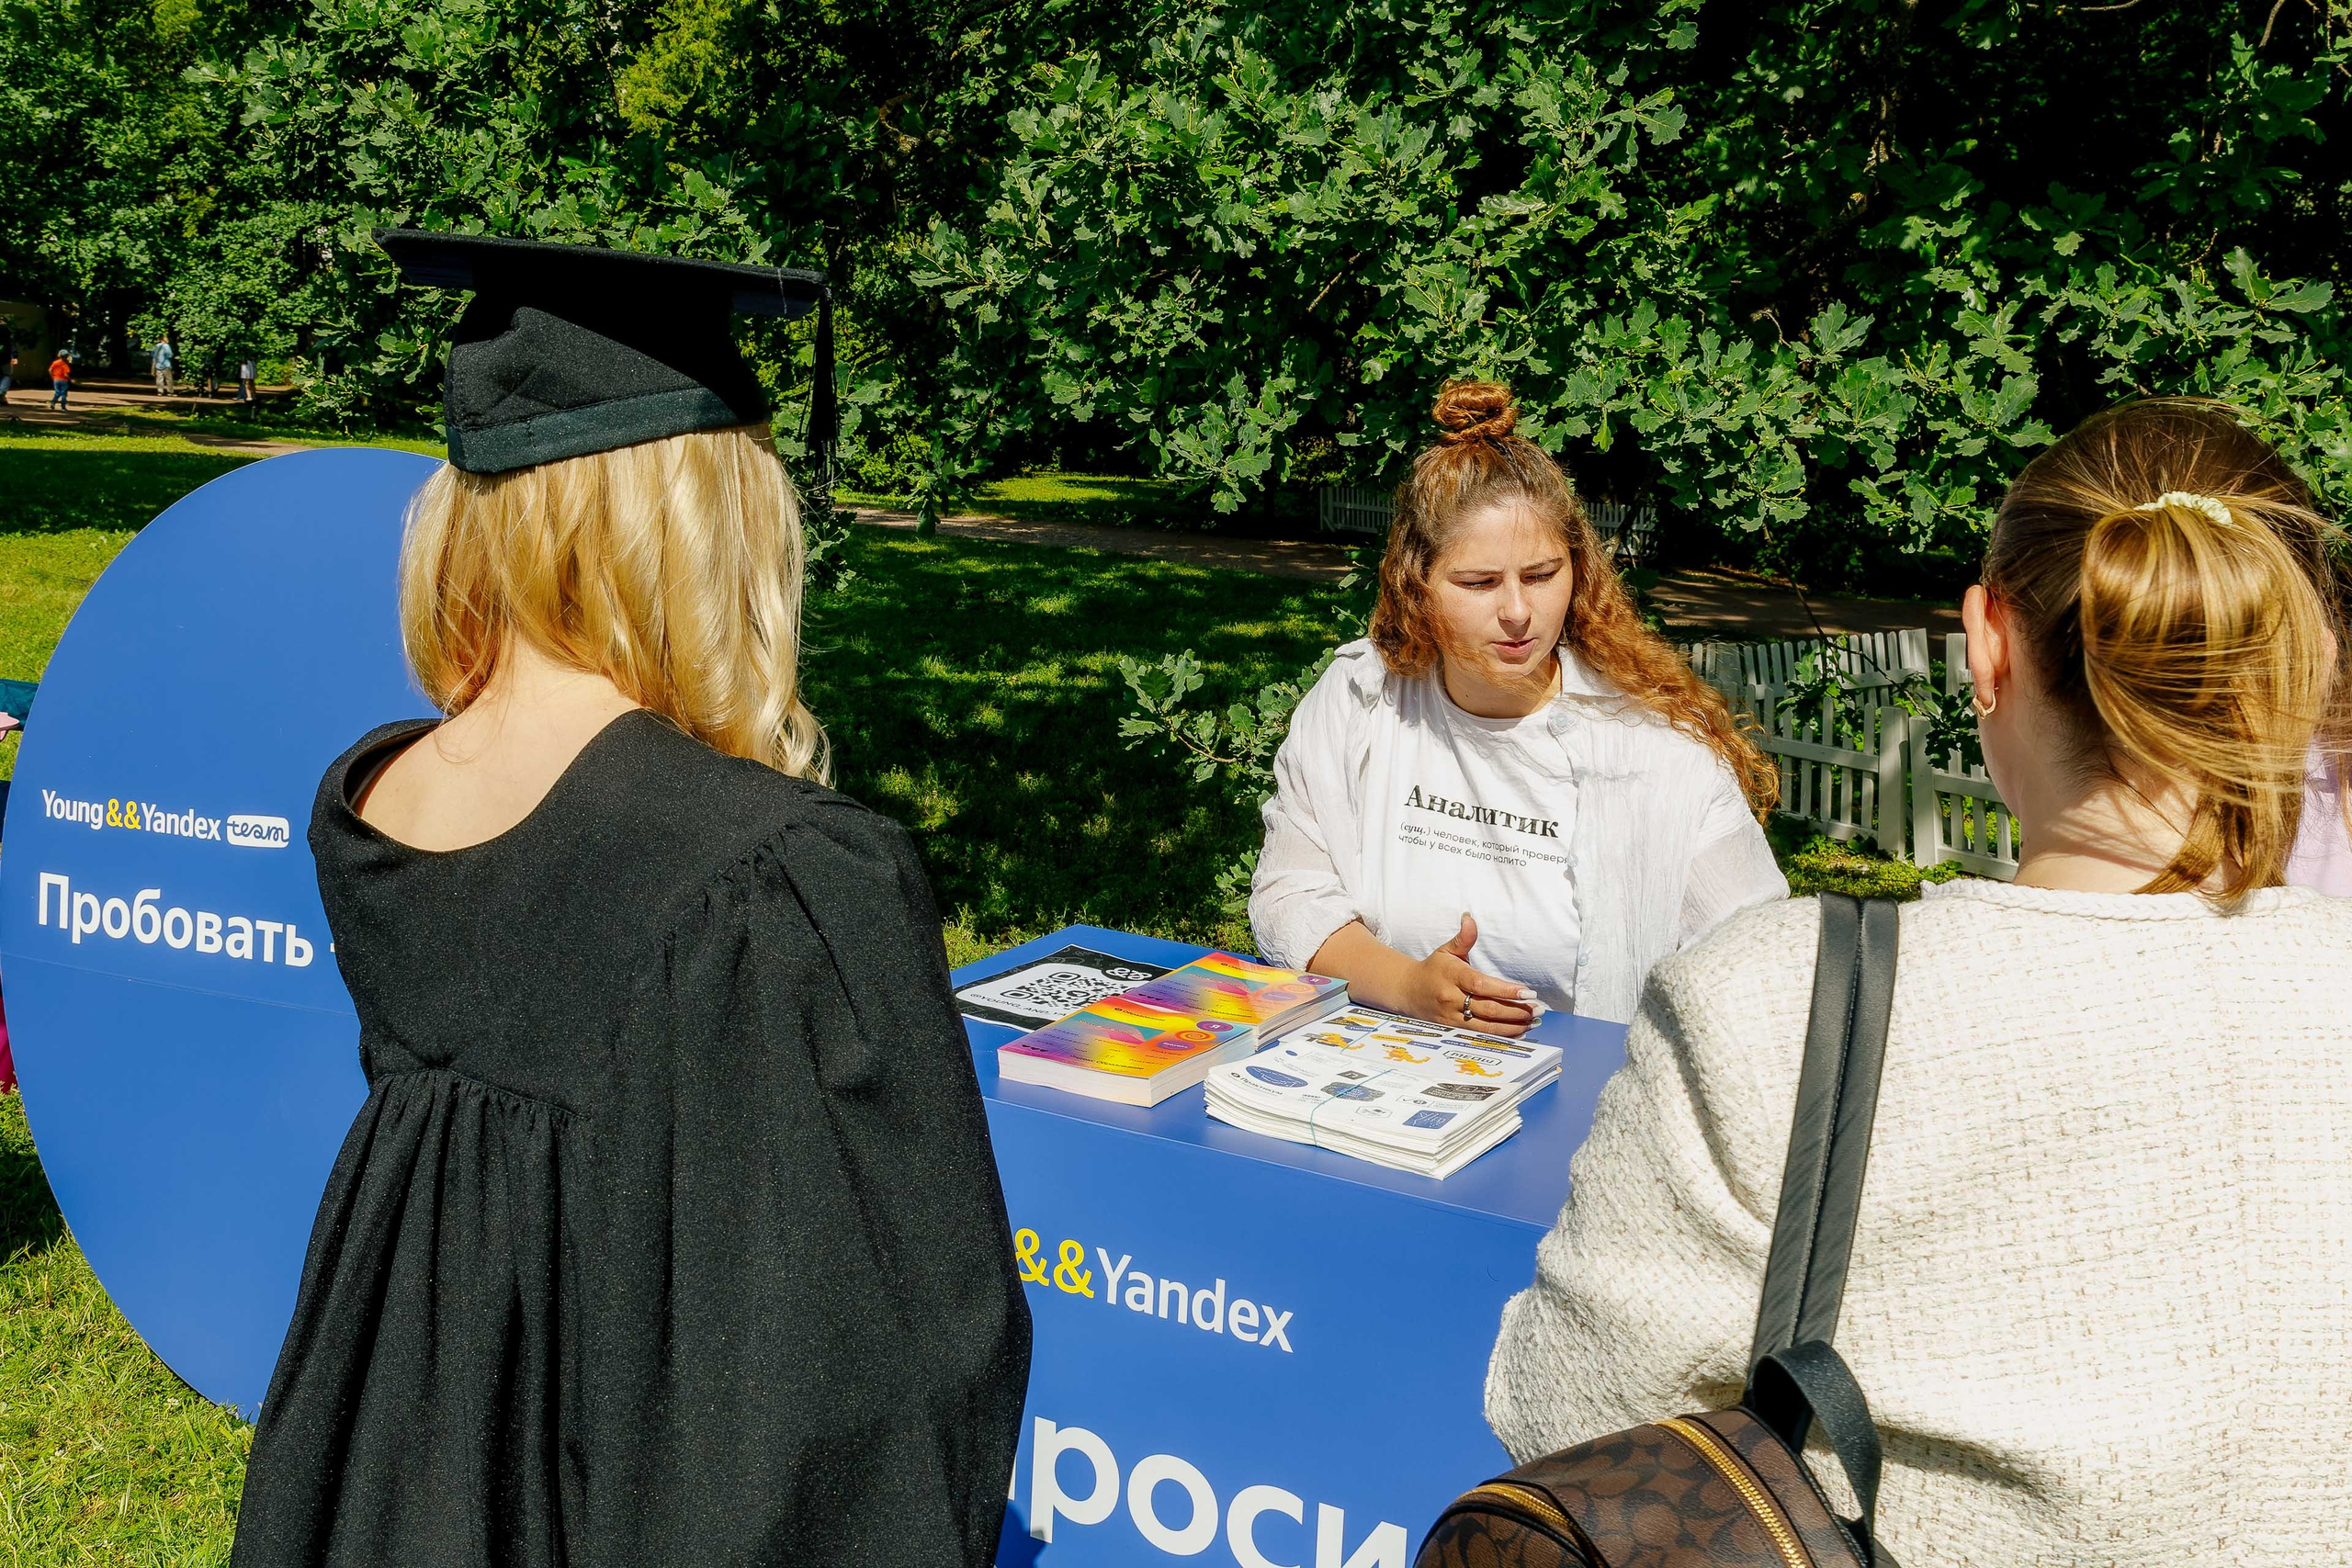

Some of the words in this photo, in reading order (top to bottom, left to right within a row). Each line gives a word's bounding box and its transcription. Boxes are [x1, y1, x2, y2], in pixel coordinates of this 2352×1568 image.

[228, 817, 289, 843] team
[1404, 784, 1559, 838] Аналитик
[1398, 834, 1427, 846] чтобы
[1430, 840, 1436, 850] у
[1438, 842, 1463, 854] всех
[1464, 848, 1492, 861] было
[1493, 854, 1527, 867] налито
[1400, 822, 1431, 835] (сущ.)
[1433, 829, 1479, 848] человек,
[1482, 840, 1520, 853] который
[38, 872, 314, 967] Пробовать
[1009, 1416, 1408, 1568] роси
